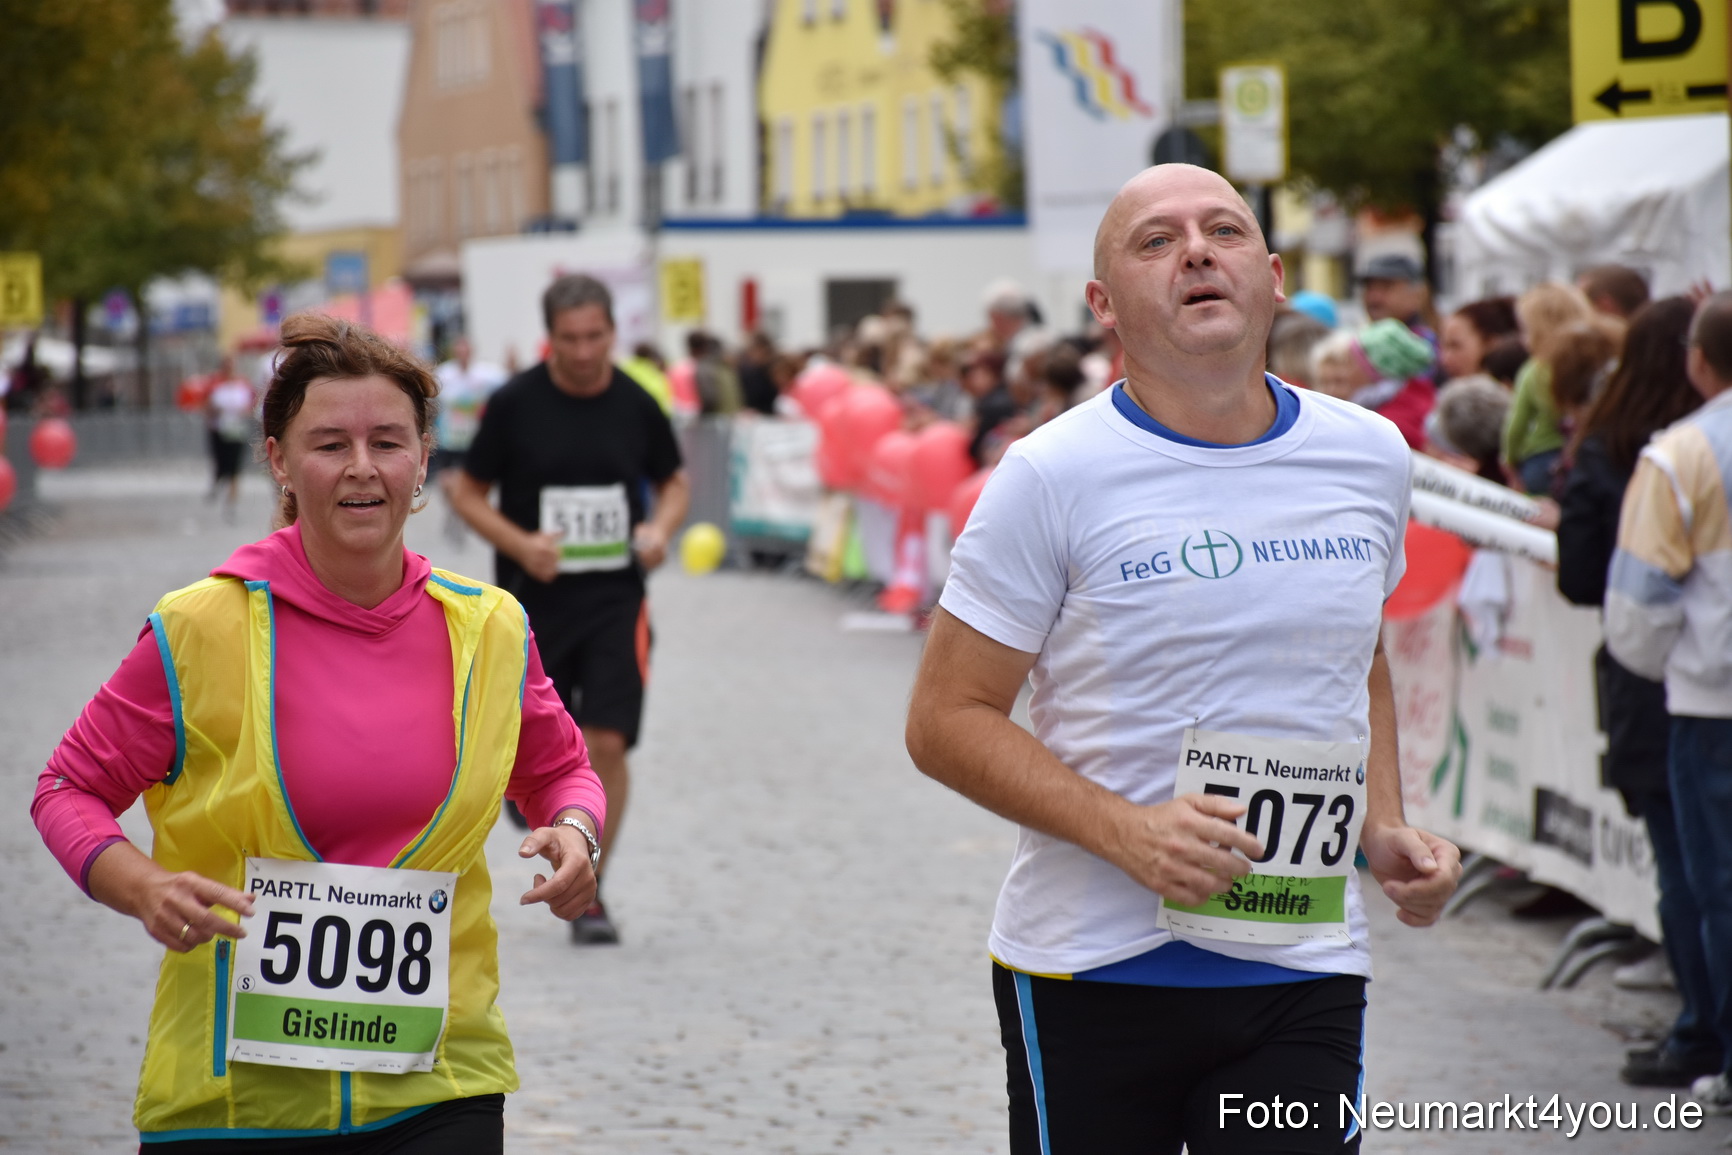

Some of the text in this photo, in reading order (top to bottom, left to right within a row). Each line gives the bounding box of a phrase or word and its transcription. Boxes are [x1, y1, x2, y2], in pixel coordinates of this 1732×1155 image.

[1119, 536, 1372, 582] FeG NEUMARKT
[1185, 749, 1351, 783] PARTL Neumarkt
[250, 878, 322, 902] PARTL
[327, 885, 422, 909] Neumarkt
[1224, 882, 1311, 916] Sandra
[260, 910, 433, 996] 5098
[282, 1007, 397, 1045] Gislinde
